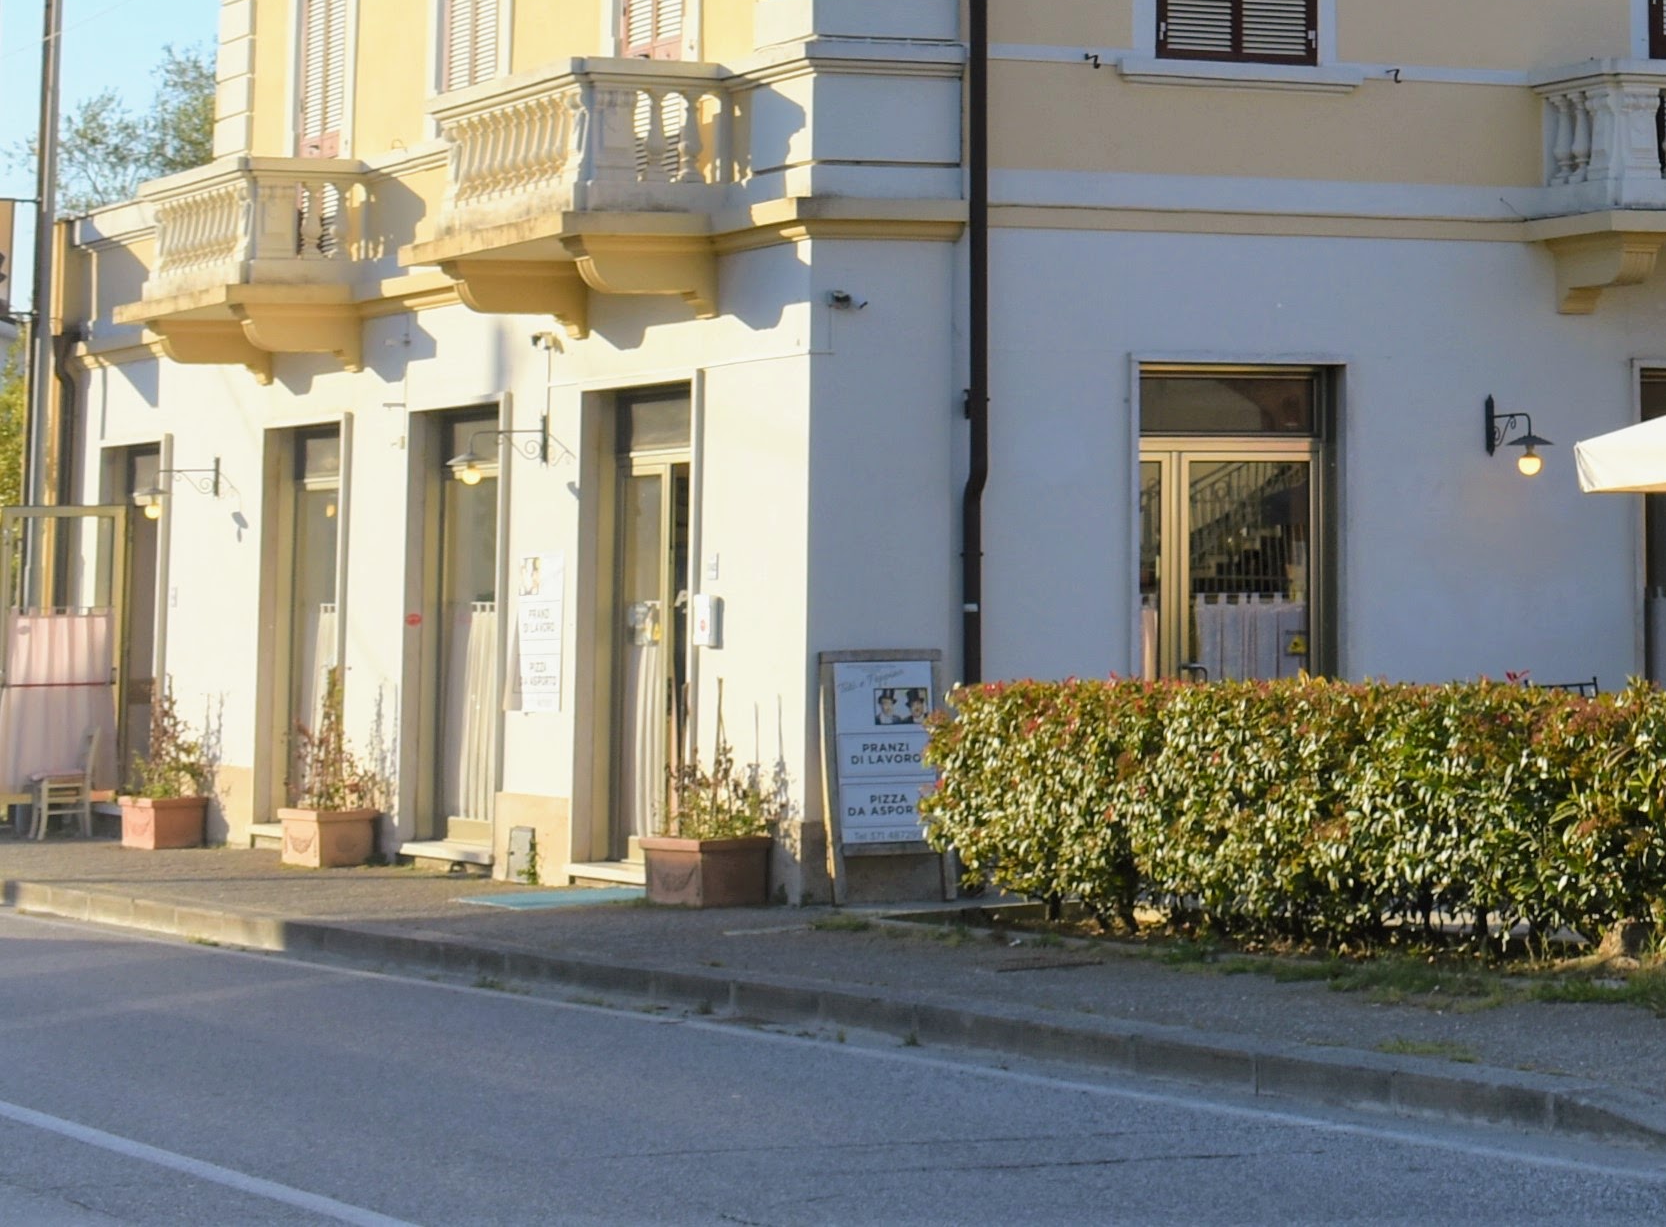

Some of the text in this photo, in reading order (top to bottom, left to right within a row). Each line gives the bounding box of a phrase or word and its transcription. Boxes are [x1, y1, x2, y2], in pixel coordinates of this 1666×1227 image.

[862, 742, 909, 752] PRANZI
[851, 753, 921, 765] DI LAVORO
[870, 794, 907, 804] PIZZA
[848, 805, 913, 816] DA ASPOR
